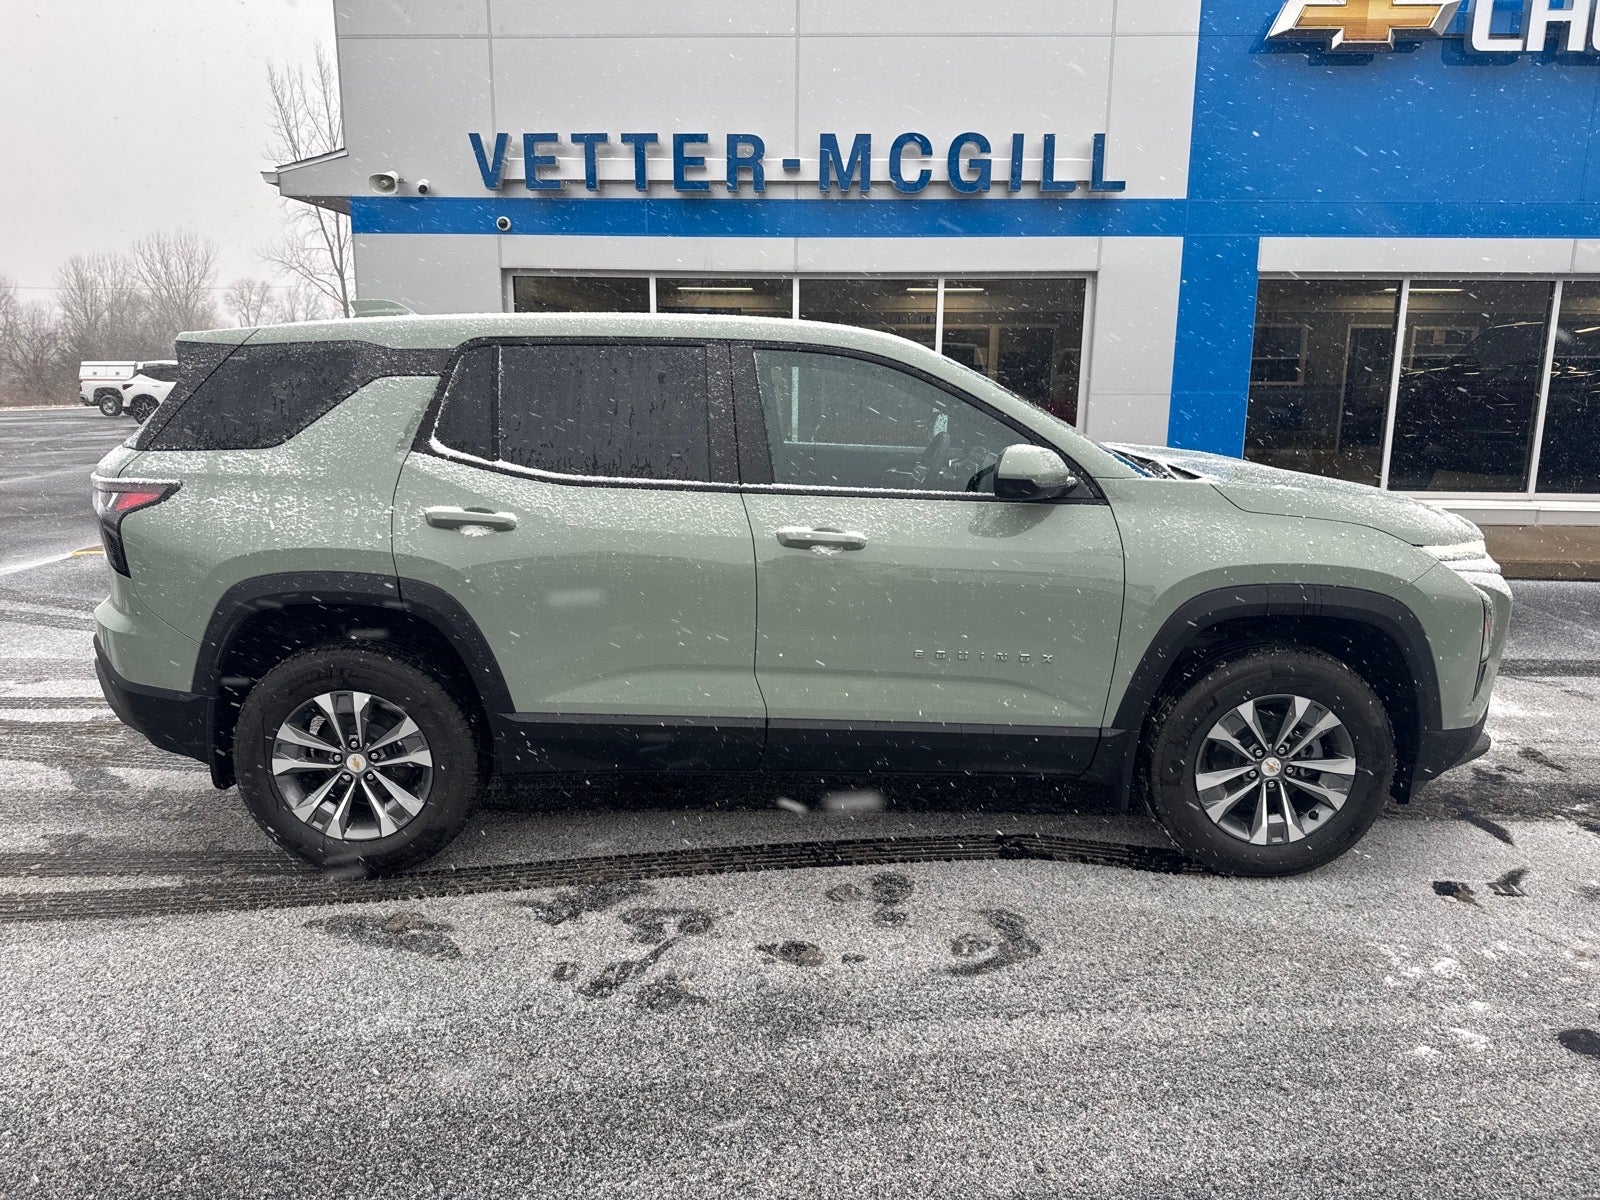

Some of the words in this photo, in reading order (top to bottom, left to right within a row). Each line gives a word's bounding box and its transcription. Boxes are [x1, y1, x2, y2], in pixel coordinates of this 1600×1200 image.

[1471, 0, 1600, 52] CH
[467, 131, 1127, 194] VETTER-MCGILL
[913, 649, 1053, 664] EQUINOX
